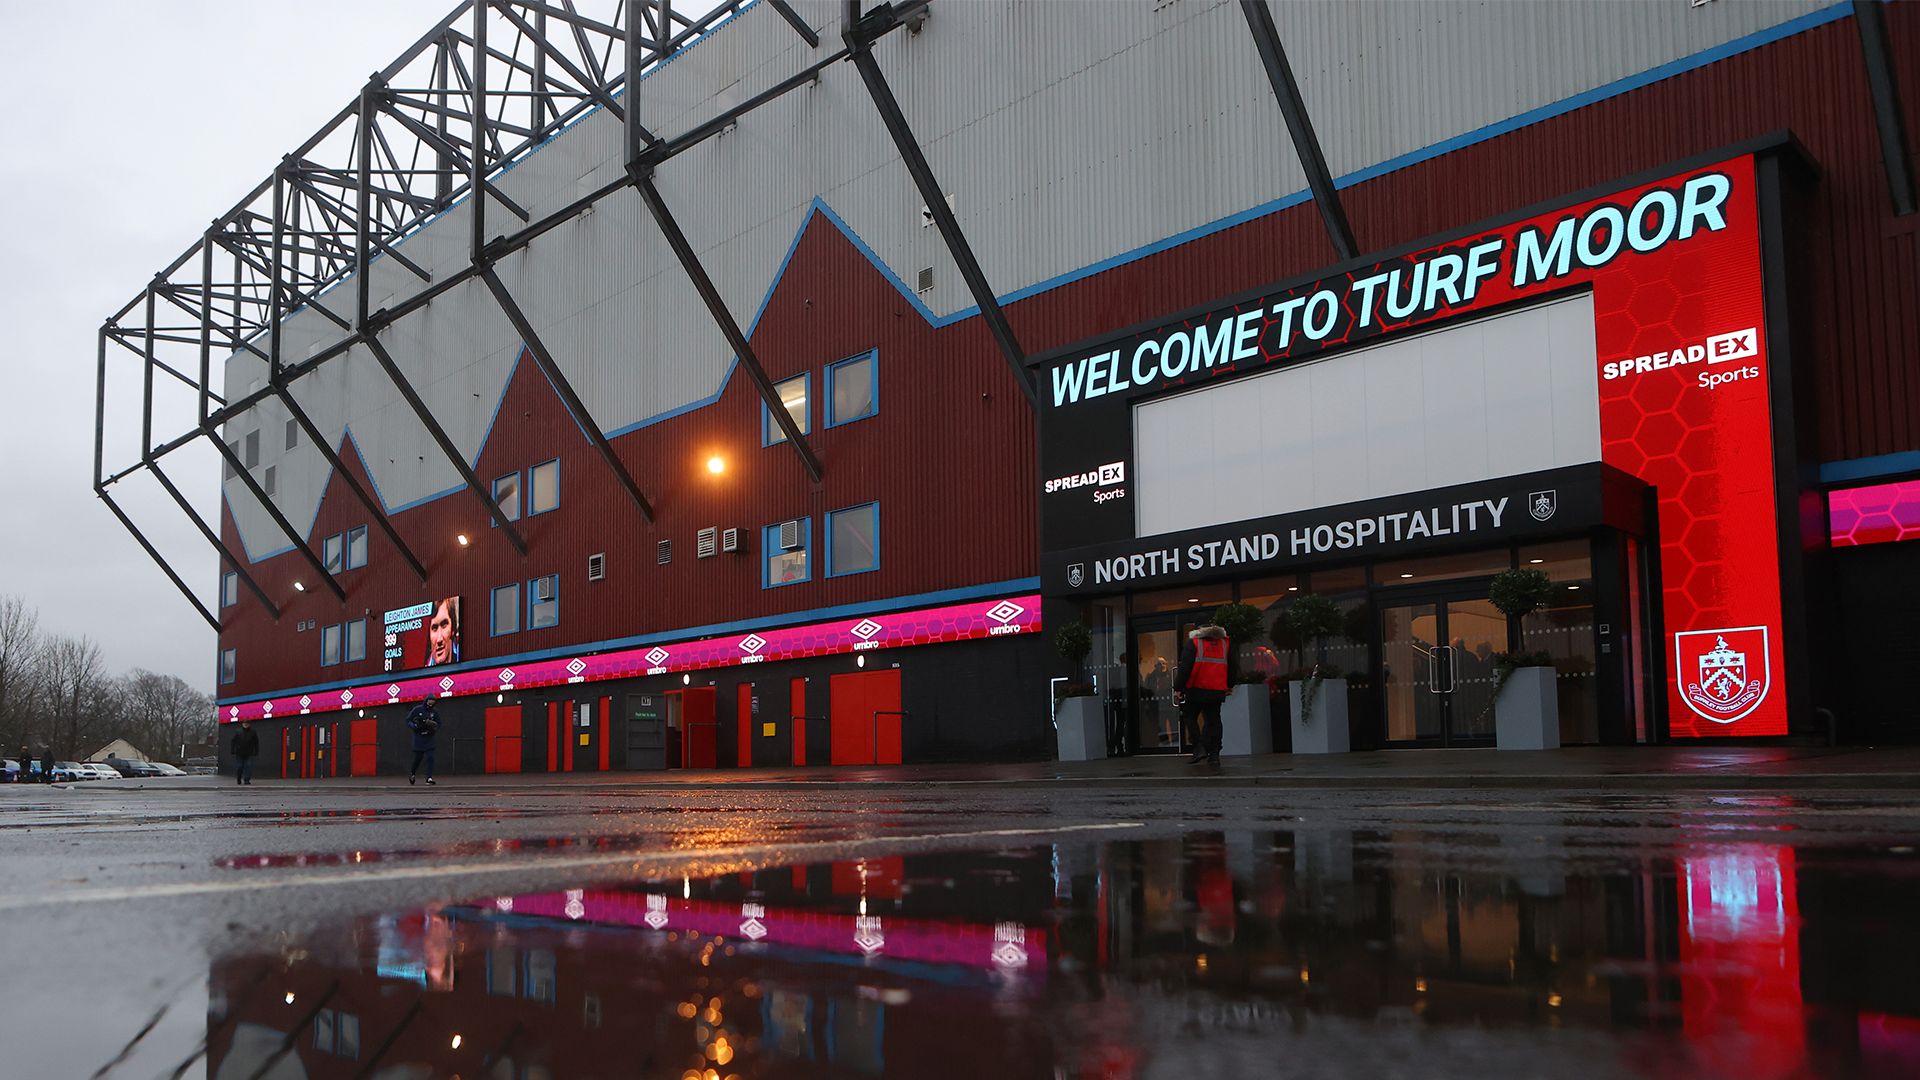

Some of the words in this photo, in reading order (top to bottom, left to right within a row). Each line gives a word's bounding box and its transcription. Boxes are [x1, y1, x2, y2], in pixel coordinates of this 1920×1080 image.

[1051, 308, 1263, 407] WELCOME
[1272, 289, 1339, 349] TO
[1352, 239, 1502, 328] TURF
[1513, 174, 1730, 287] MOOR
[1603, 327, 1757, 380] SPREADEX
[1698, 366, 1759, 389] Sports
[1045, 461, 1124, 493] SPREADEX
[1093, 488, 1125, 504] Sports
[1095, 547, 1180, 584] NORTH
[1187, 533, 1280, 570] STAND
[1290, 497, 1509, 556] HOSPITALITY
[386, 608, 411, 622] LEIGHTON
[411, 604, 430, 617] JAMES
[385, 619, 422, 634] APPEARANCES
[990, 624, 1020, 635] umbro
[384, 633, 397, 647] 399
[853, 640, 879, 650] umbro
[385, 647, 402, 658] GOALS
[741, 654, 763, 664] umbro
[384, 658, 392, 671] 81
[646, 667, 667, 675] umbro
